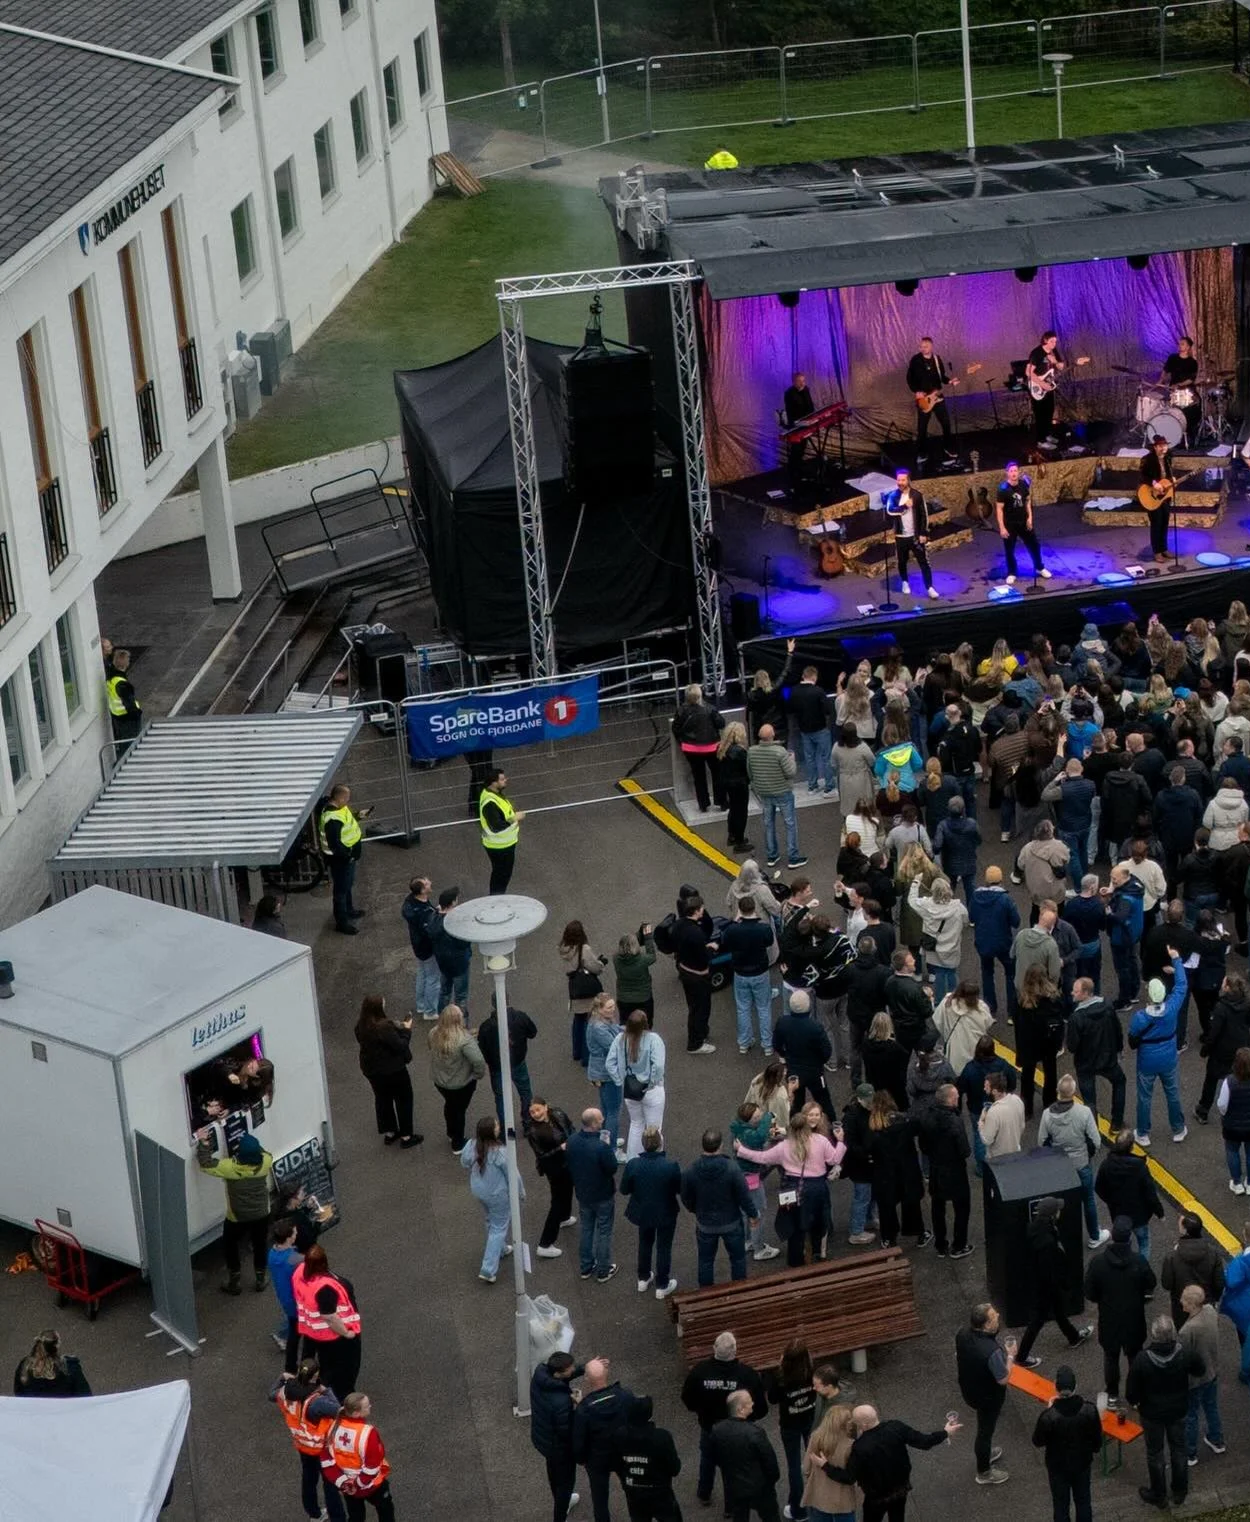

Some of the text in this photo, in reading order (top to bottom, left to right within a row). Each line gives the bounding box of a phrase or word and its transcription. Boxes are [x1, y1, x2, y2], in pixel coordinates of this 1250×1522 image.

[92, 163, 166, 247] KOMMUNEHUSET
[430, 700, 568, 733] SpareBank 1
[436, 718, 543, 743] SOGN OG FJORDANE
[275, 1138, 321, 1178] SIDER
